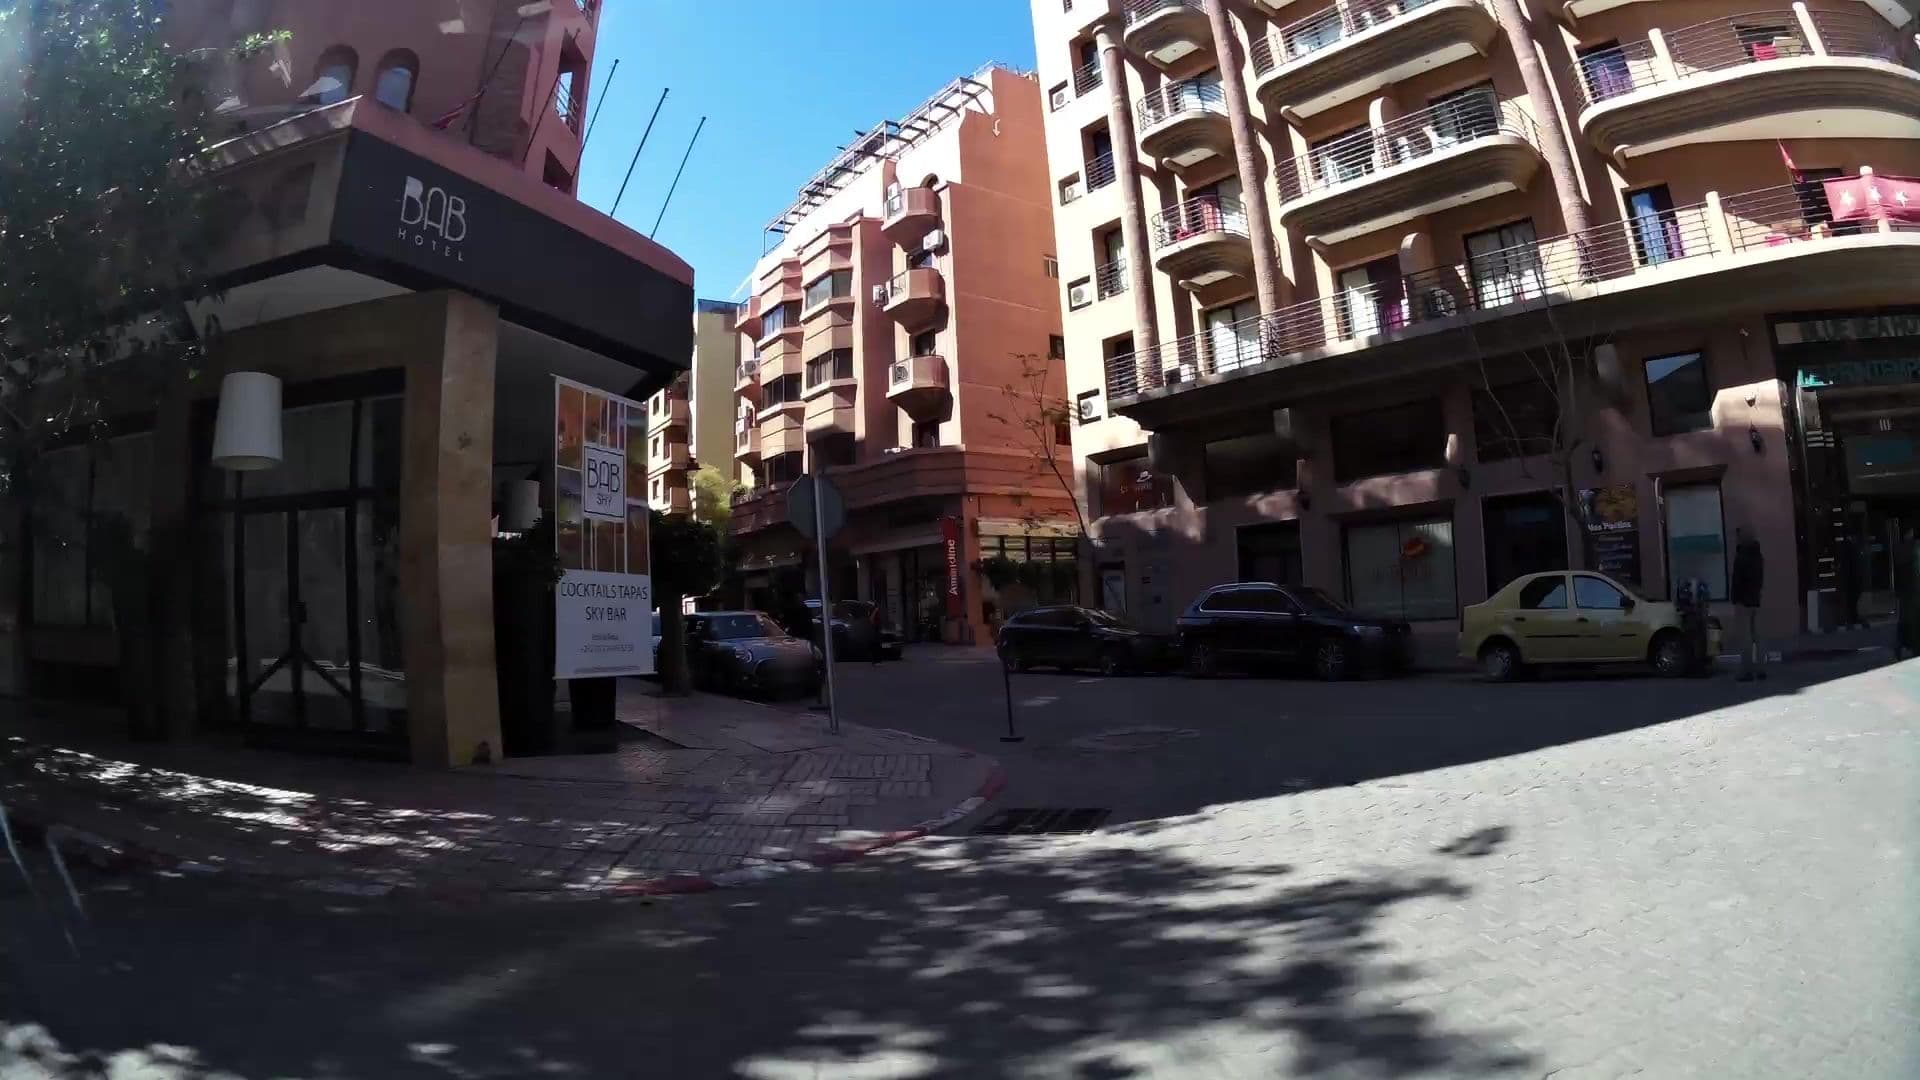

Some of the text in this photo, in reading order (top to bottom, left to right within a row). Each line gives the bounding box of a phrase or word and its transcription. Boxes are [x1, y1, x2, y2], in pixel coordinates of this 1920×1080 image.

[400, 175, 466, 242] BAB
[398, 227, 464, 262] HOTEL
[587, 457, 621, 493] BAB
[560, 581, 649, 600] COCKTAILS TAPAS
[585, 605, 628, 622] SKY BAR
